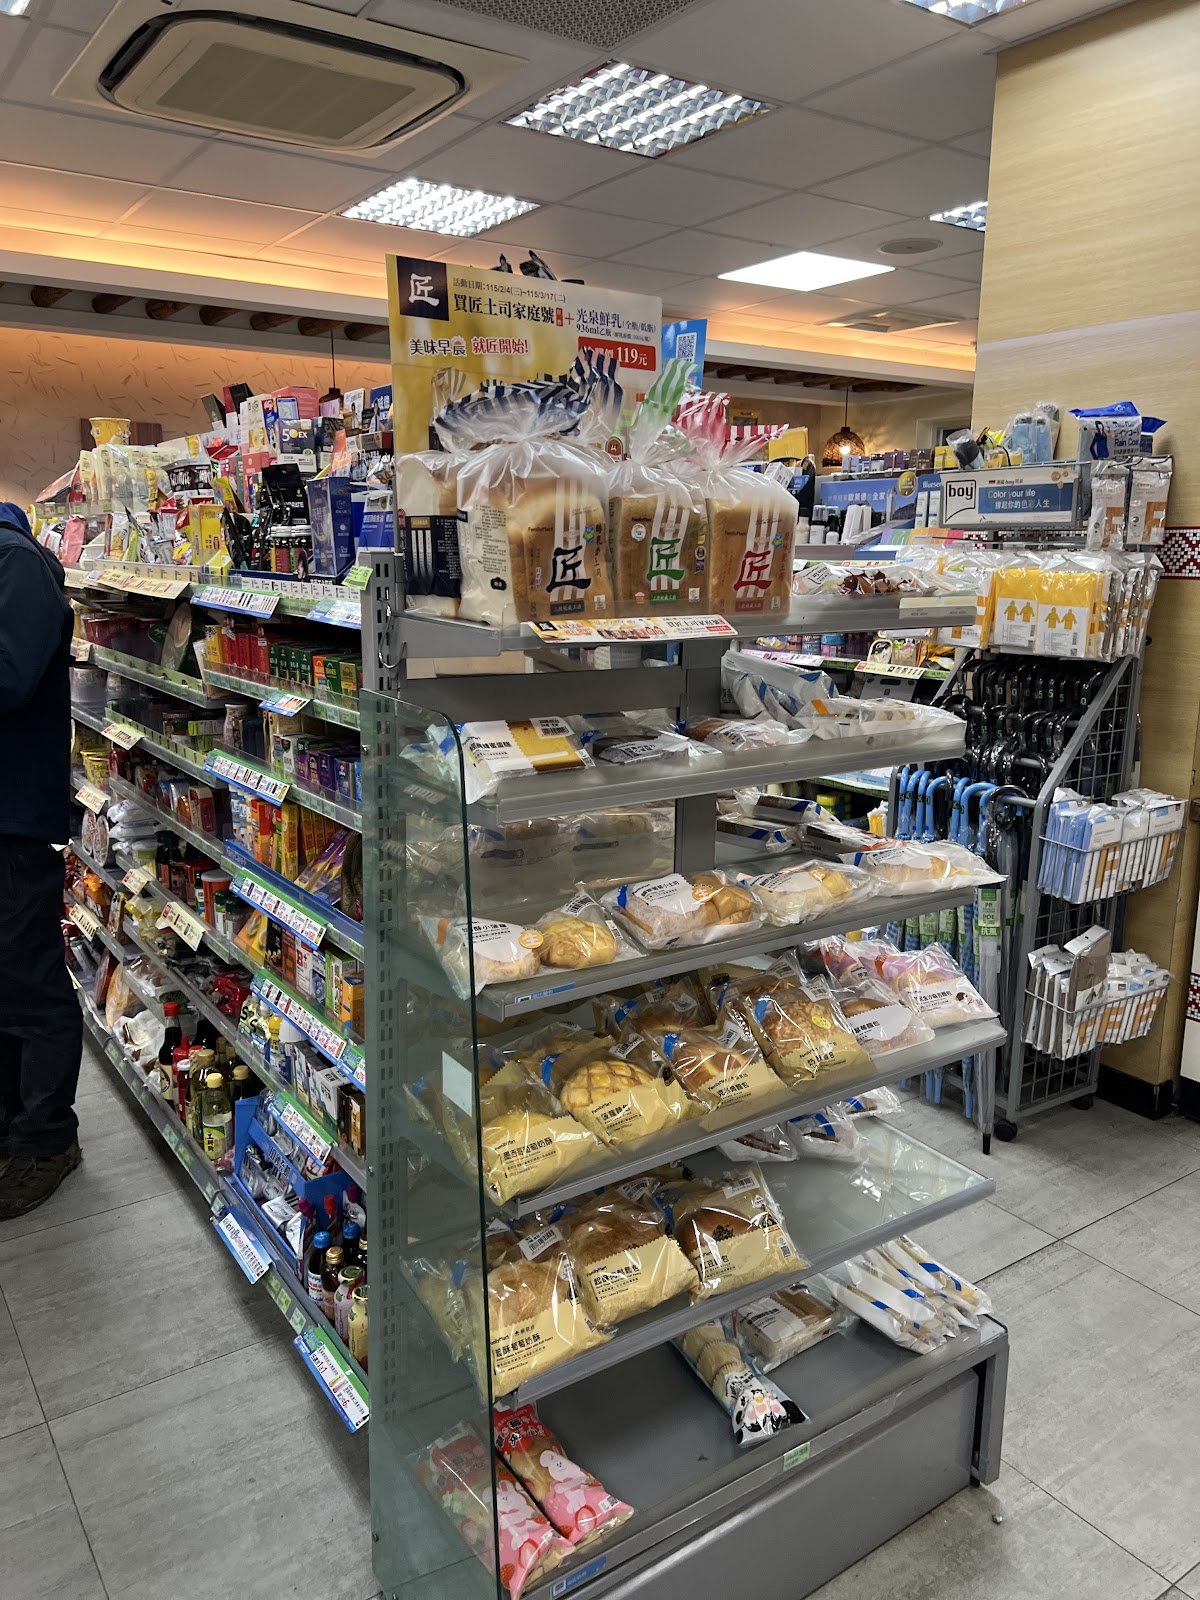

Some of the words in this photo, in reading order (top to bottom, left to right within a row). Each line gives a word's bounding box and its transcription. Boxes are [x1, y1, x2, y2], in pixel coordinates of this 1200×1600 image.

[408, 273, 439, 306] 匠
[454, 293, 555, 324] 買匠土司家庭號
[576, 308, 622, 329] 光泉鮮乳
[410, 338, 466, 356] 美味早晨
[472, 337, 528, 354] 就匠開始!
[948, 483, 974, 500] boy
[988, 490, 1007, 499] Color
[1008, 490, 1024, 499] your
[646, 537, 685, 581] 匠
[546, 545, 591, 593] 匠
[733, 550, 772, 591] 匠
[522, 933, 541, 947] 生
[591, 1101, 612, 1114] FamilyMart
[494, 1139, 516, 1151] FamilyMart
[504, 1137, 553, 1160] 墨西哥葡萄奶酥
[586, 1265, 608, 1277] FamilyMart
[490, 1335, 509, 1345] amilyMart
